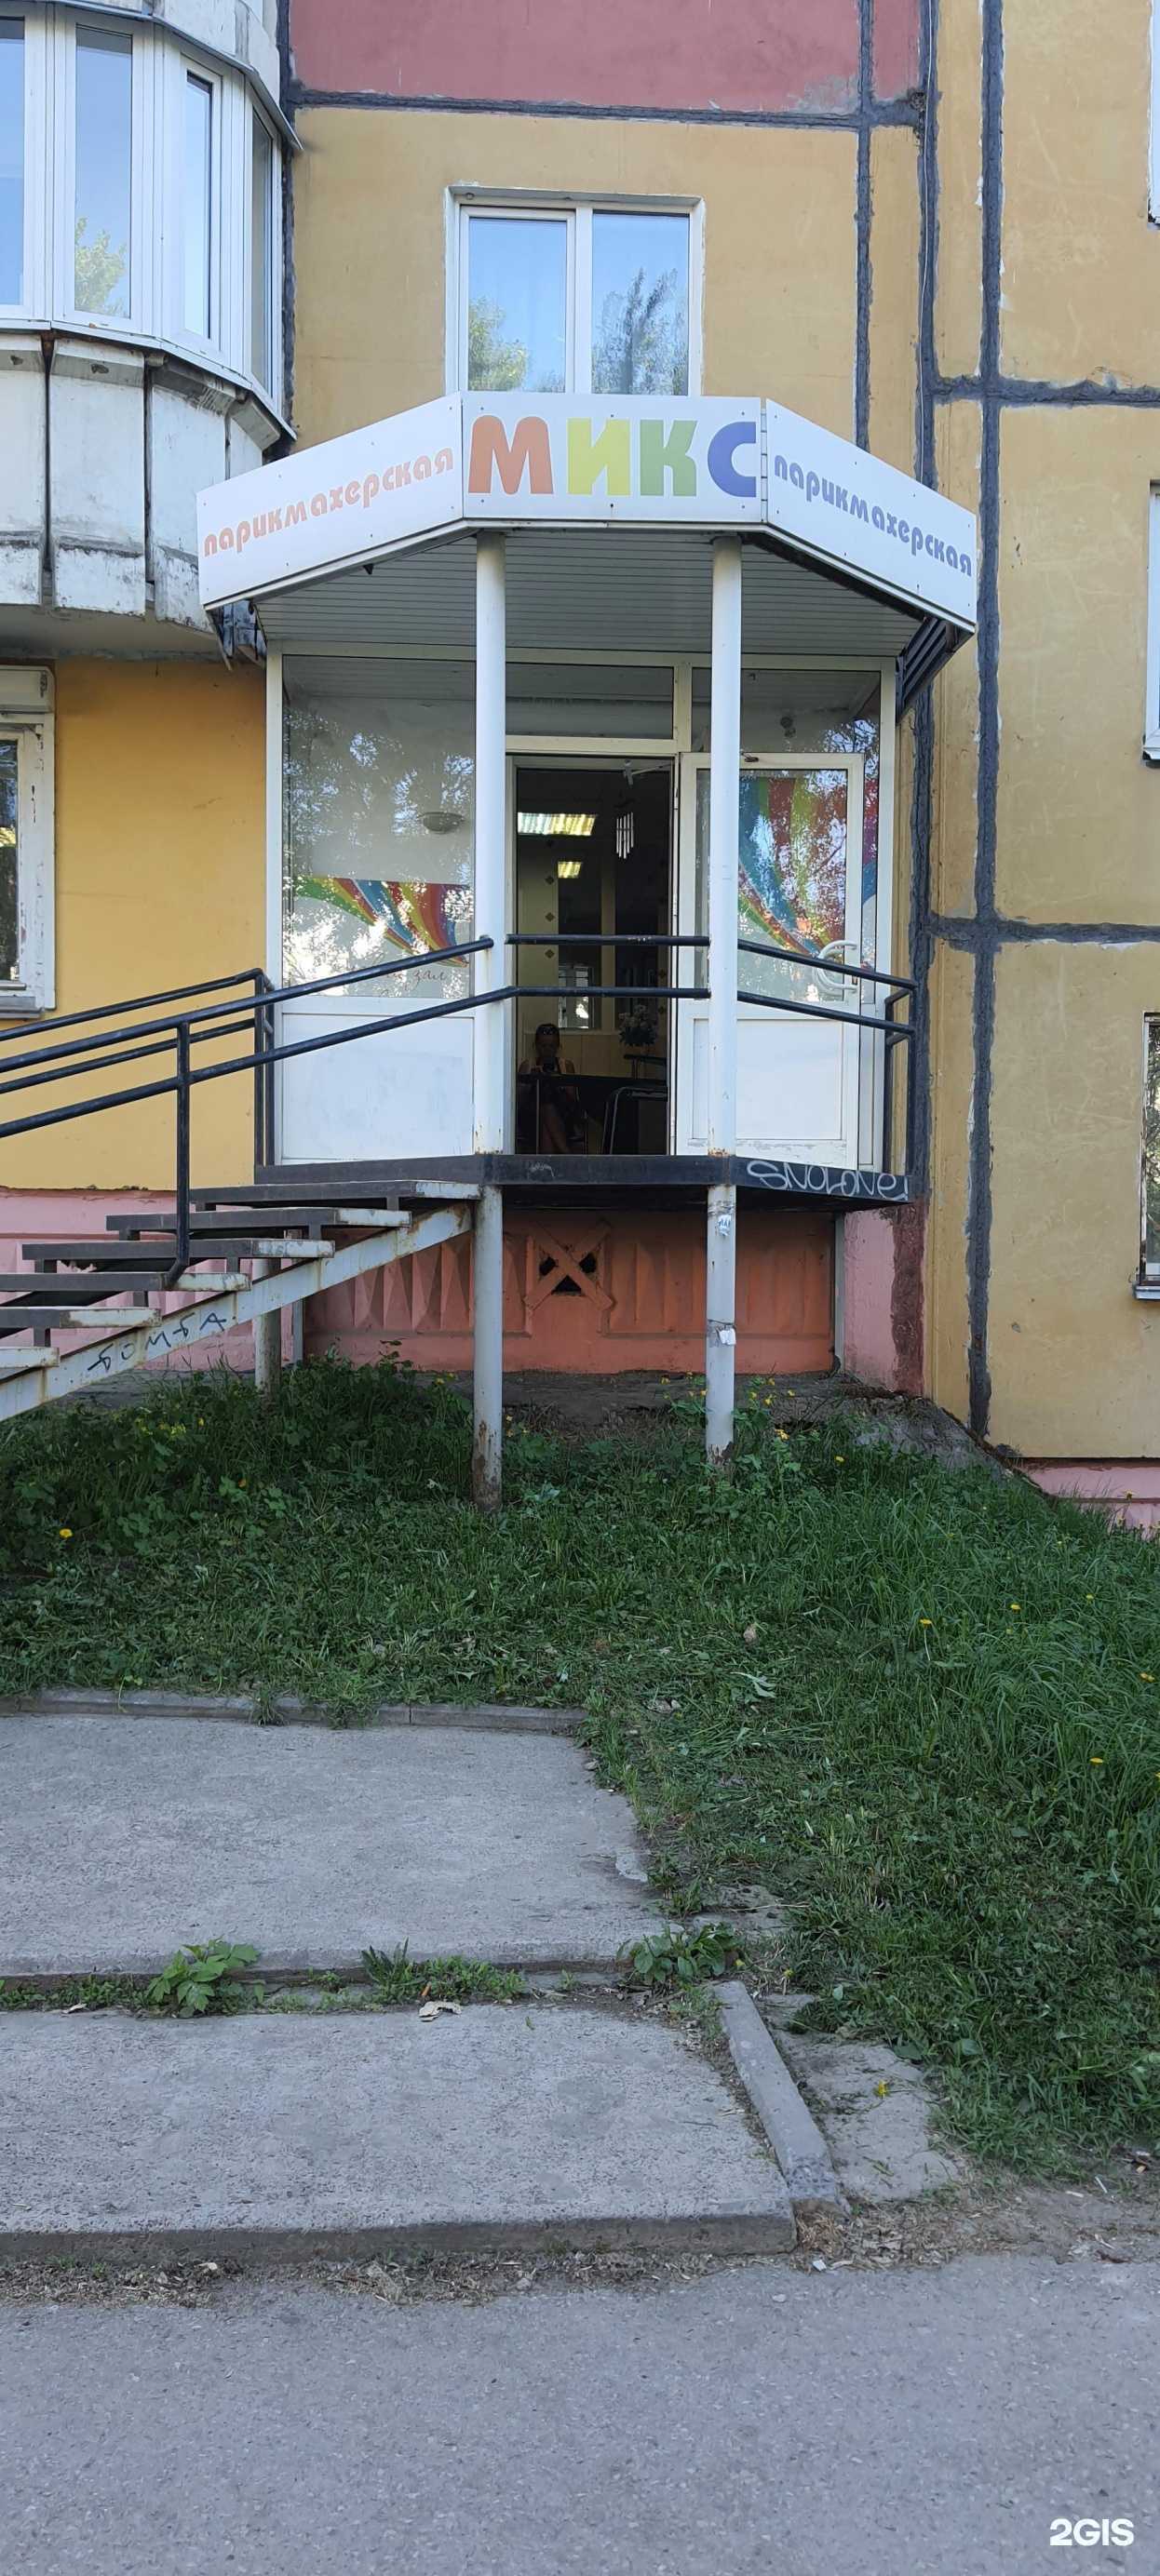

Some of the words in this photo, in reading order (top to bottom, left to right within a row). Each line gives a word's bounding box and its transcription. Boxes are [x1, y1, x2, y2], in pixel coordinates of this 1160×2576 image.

[204, 447, 454, 557] парикмахерская
[468, 414, 757, 498] МИКС
[774, 455, 972, 577] парикмахерская
